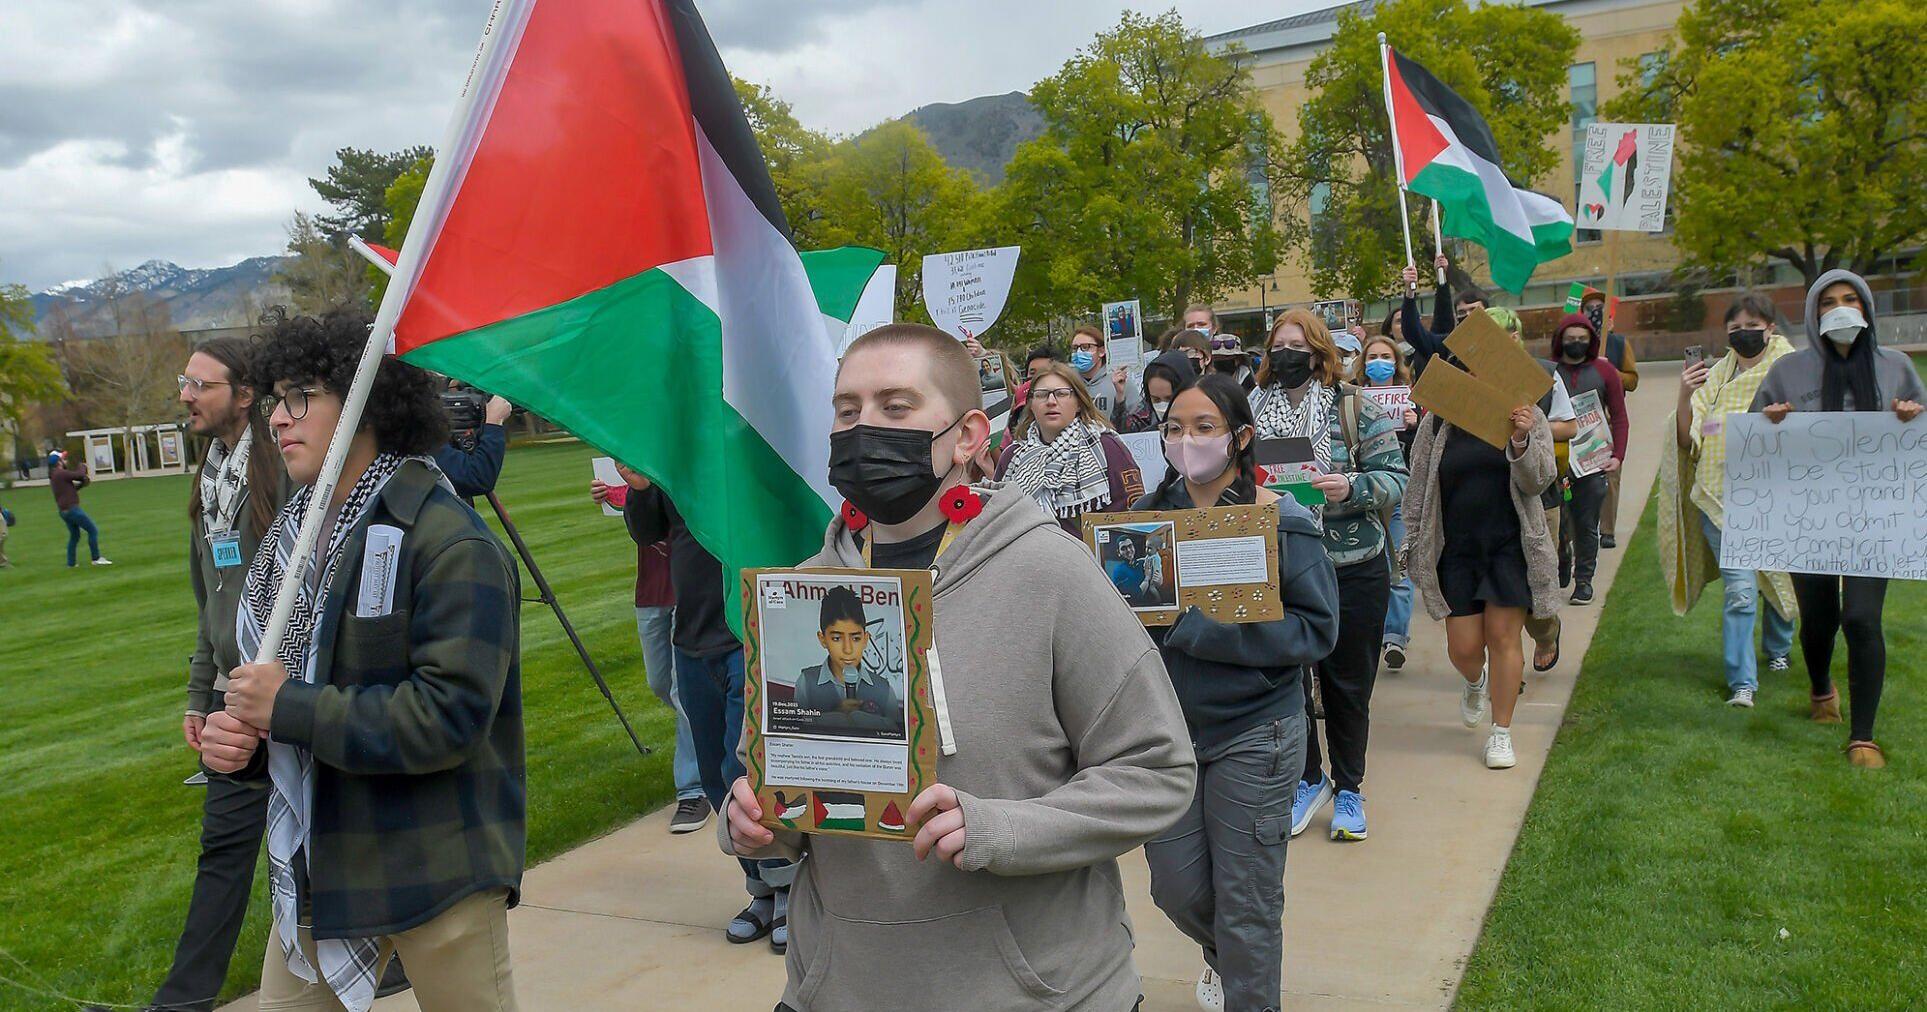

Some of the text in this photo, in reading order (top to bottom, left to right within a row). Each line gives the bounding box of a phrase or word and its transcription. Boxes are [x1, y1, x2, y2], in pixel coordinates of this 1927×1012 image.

[1584, 126, 1607, 175] FREE
[1639, 127, 1672, 230] PALESTINE
[1734, 422, 1789, 462] Your
[1269, 464, 1286, 474] FREE
[1788, 459, 1825, 482] be
[1730, 482, 1774, 514] by
[1787, 487, 1842, 518] your
[1847, 483, 1905, 516] grand
[1784, 513, 1828, 541] you
[1836, 505, 1904, 534] admit
[773, 707, 821, 717] Essam Shahin
